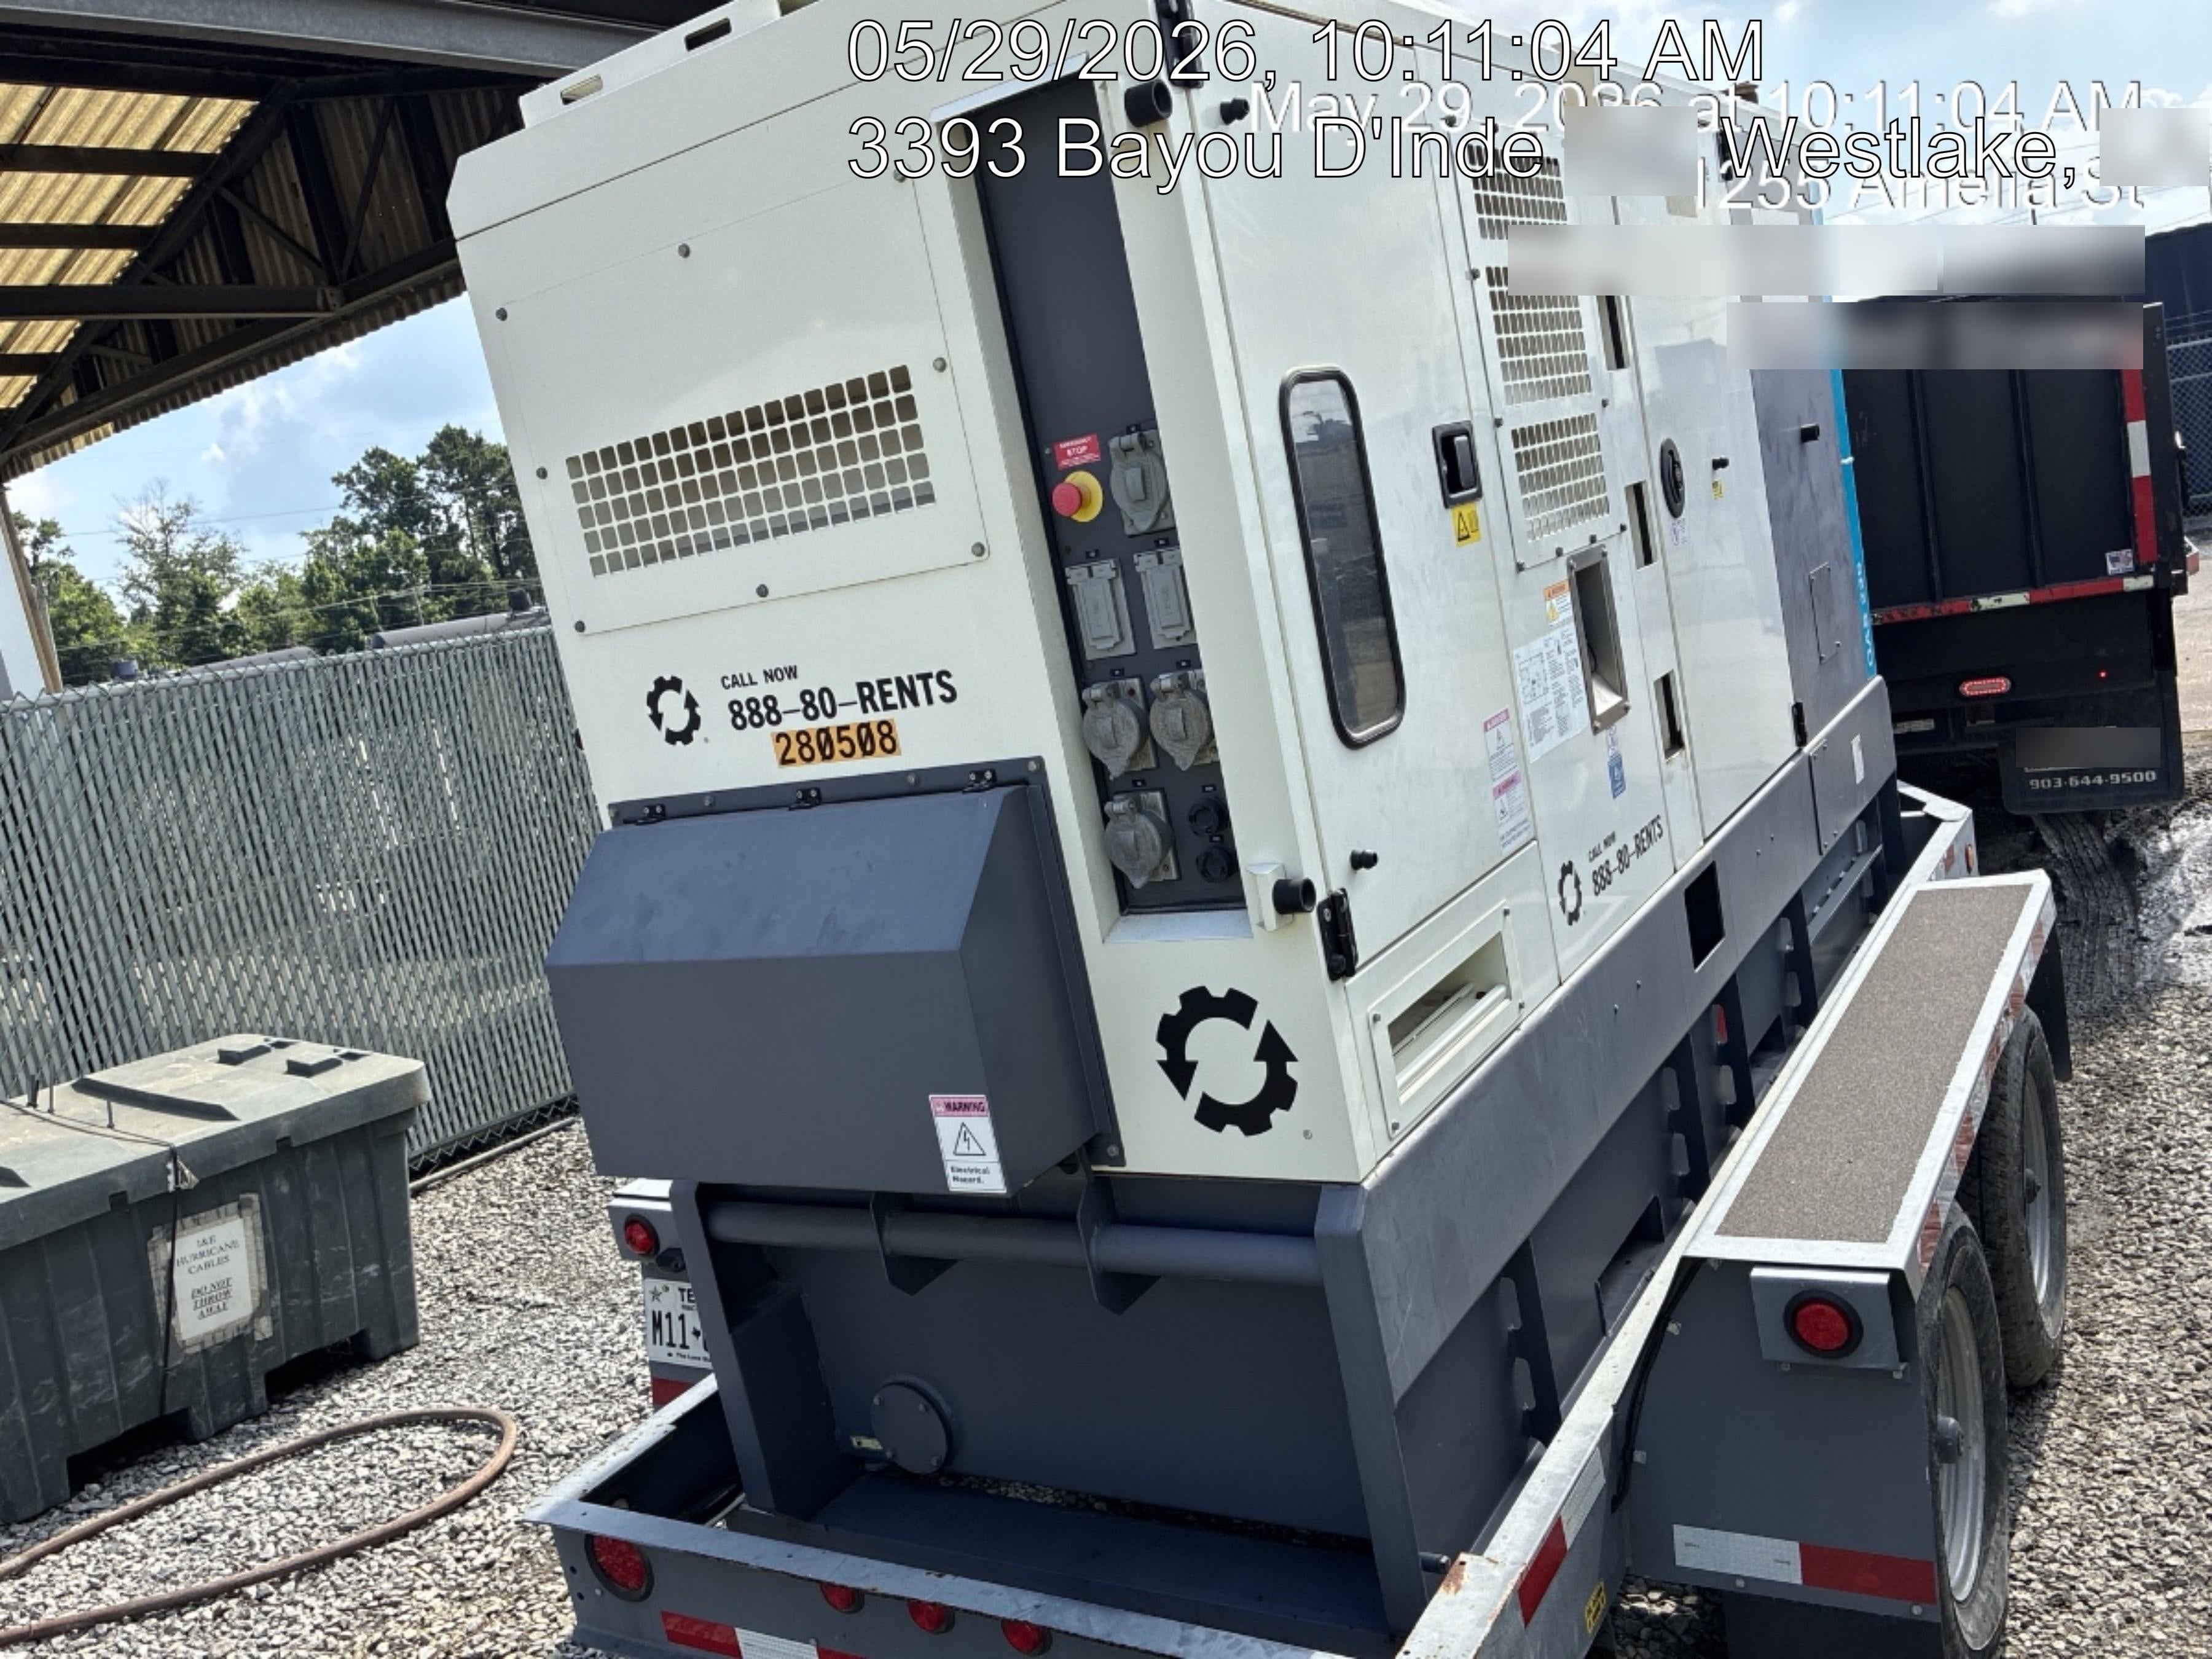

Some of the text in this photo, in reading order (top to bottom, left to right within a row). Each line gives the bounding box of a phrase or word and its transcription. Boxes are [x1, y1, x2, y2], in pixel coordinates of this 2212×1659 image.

[720, 664, 798, 690] CALL NOW
[728, 669, 958, 731] 888-80-RENTS
[775, 720, 898, 766] 280508
[944, 1101, 986, 1112] WARNING
[176, 1239, 240, 1268] HURRICANE
[187, 1255, 230, 1274] CABLES
[678, 1287, 696, 1303] TE
[652, 1310, 708, 1351] M11
